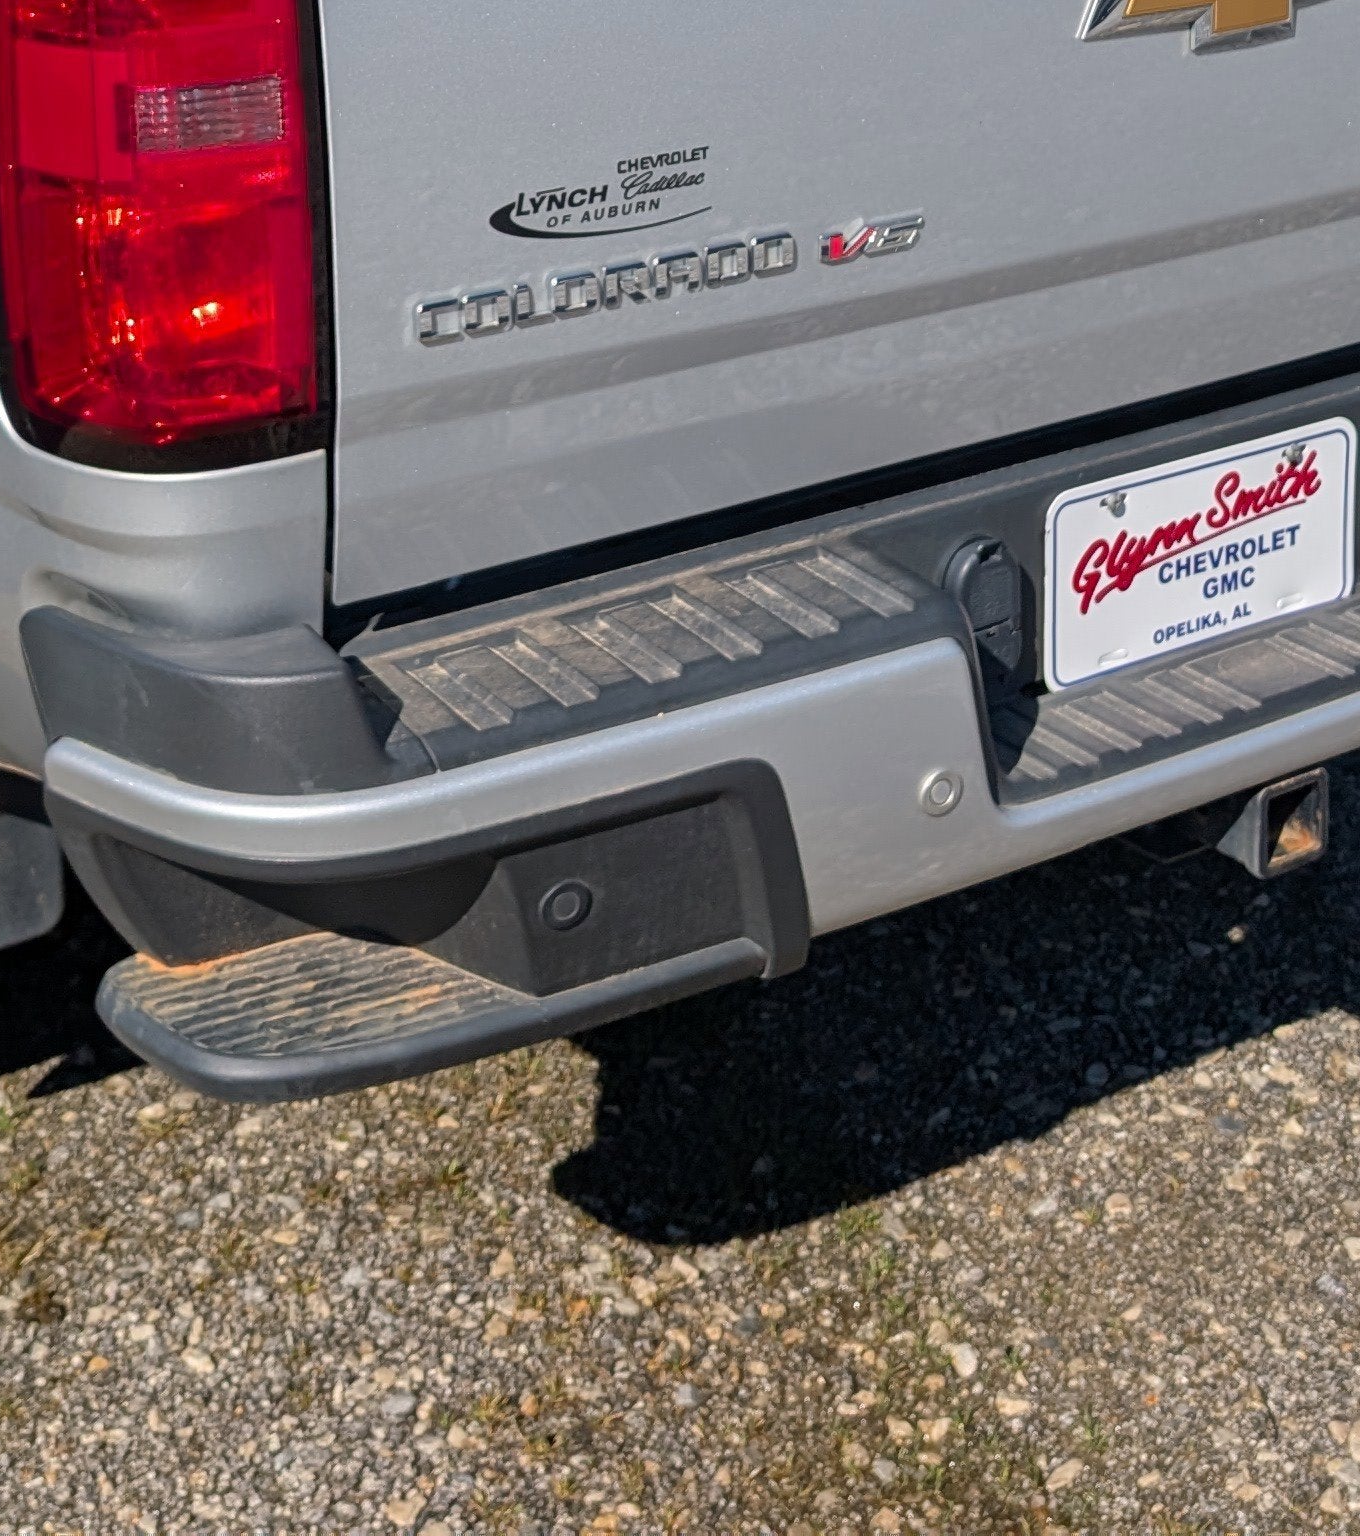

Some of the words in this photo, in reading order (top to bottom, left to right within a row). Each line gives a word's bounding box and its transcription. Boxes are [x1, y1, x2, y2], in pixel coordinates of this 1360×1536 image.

[617, 146, 709, 174] CHEVROLET
[515, 185, 608, 216] LYNCH
[620, 170, 706, 200] Cadillac
[546, 214, 572, 228] OF
[581, 198, 661, 223] AUBURN
[416, 231, 798, 347] COLORADO
[818, 214, 926, 265] V6
[1071, 512, 1201, 615] Glynn
[1206, 450, 1321, 528] Smith
[1158, 524, 1301, 584] CHEVROLET
[1202, 567, 1256, 600] GMC
[1153, 614, 1228, 644] OPELIKA,
[1231, 602, 1252, 622] AL
